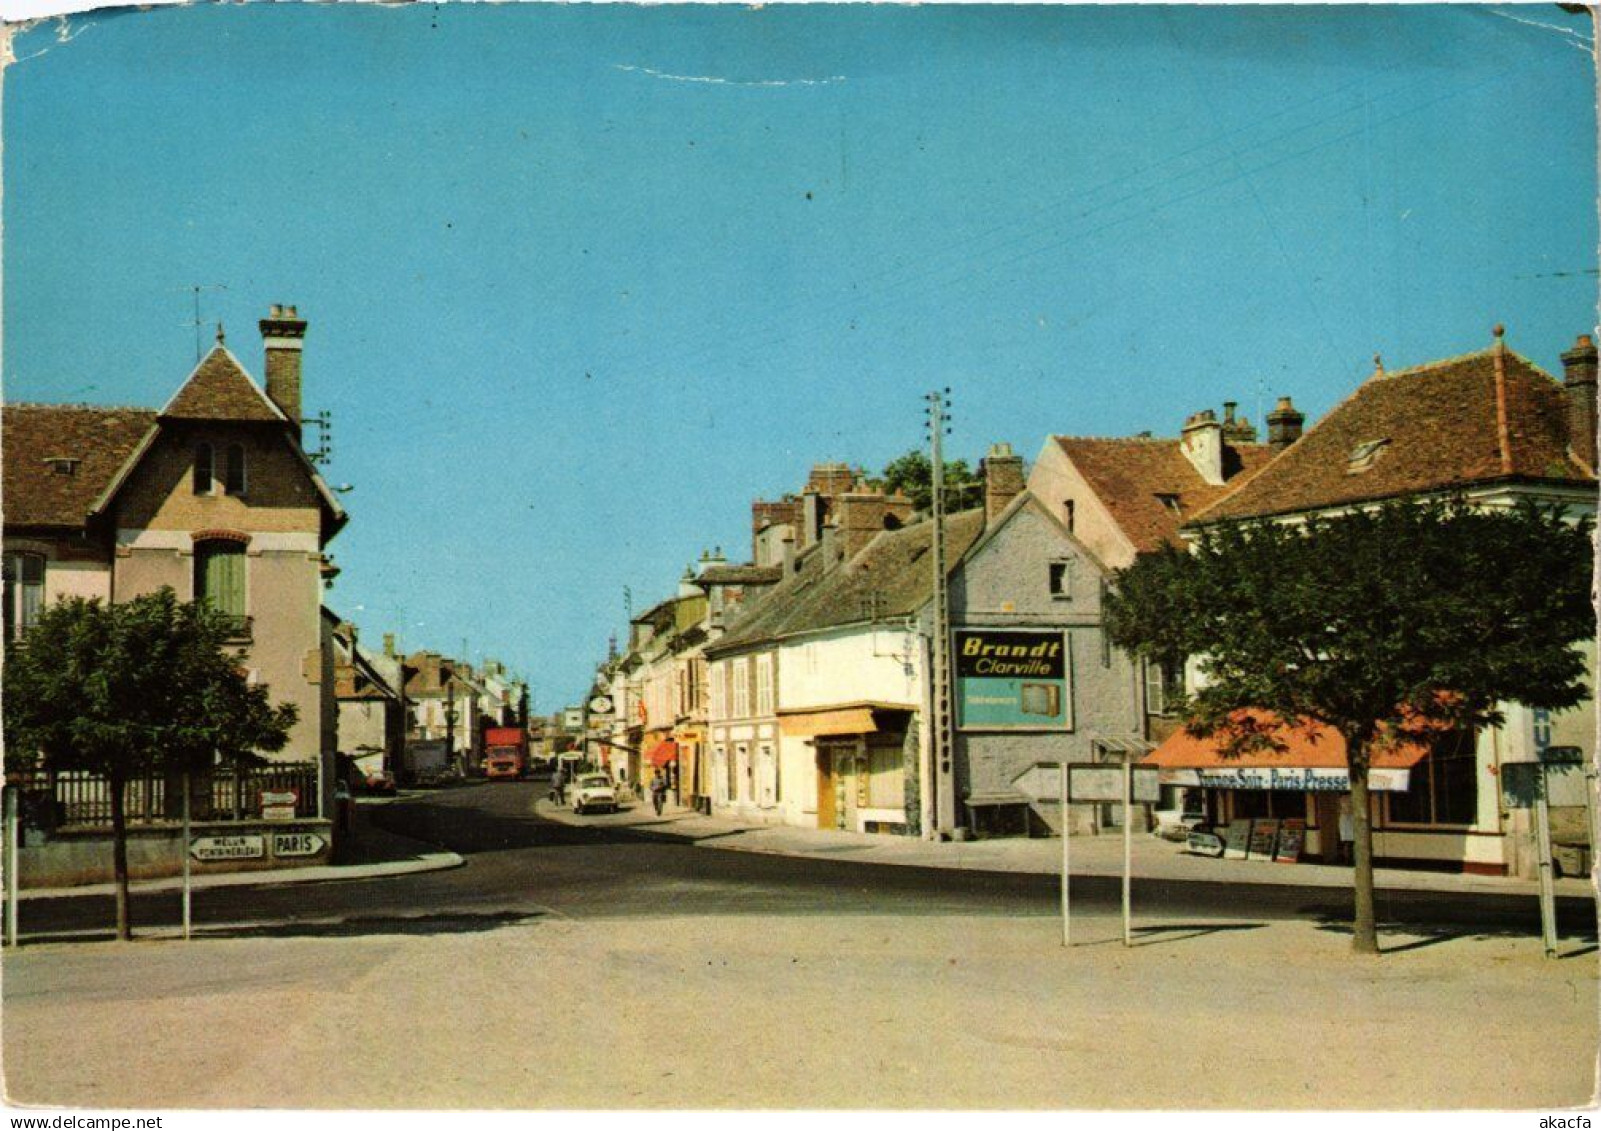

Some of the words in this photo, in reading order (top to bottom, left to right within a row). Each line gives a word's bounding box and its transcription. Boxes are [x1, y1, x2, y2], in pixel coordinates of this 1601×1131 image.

[962, 637, 1060, 658] Brandt
[976, 658, 1052, 675] Clarville
[276, 836, 313, 852] PARIS
